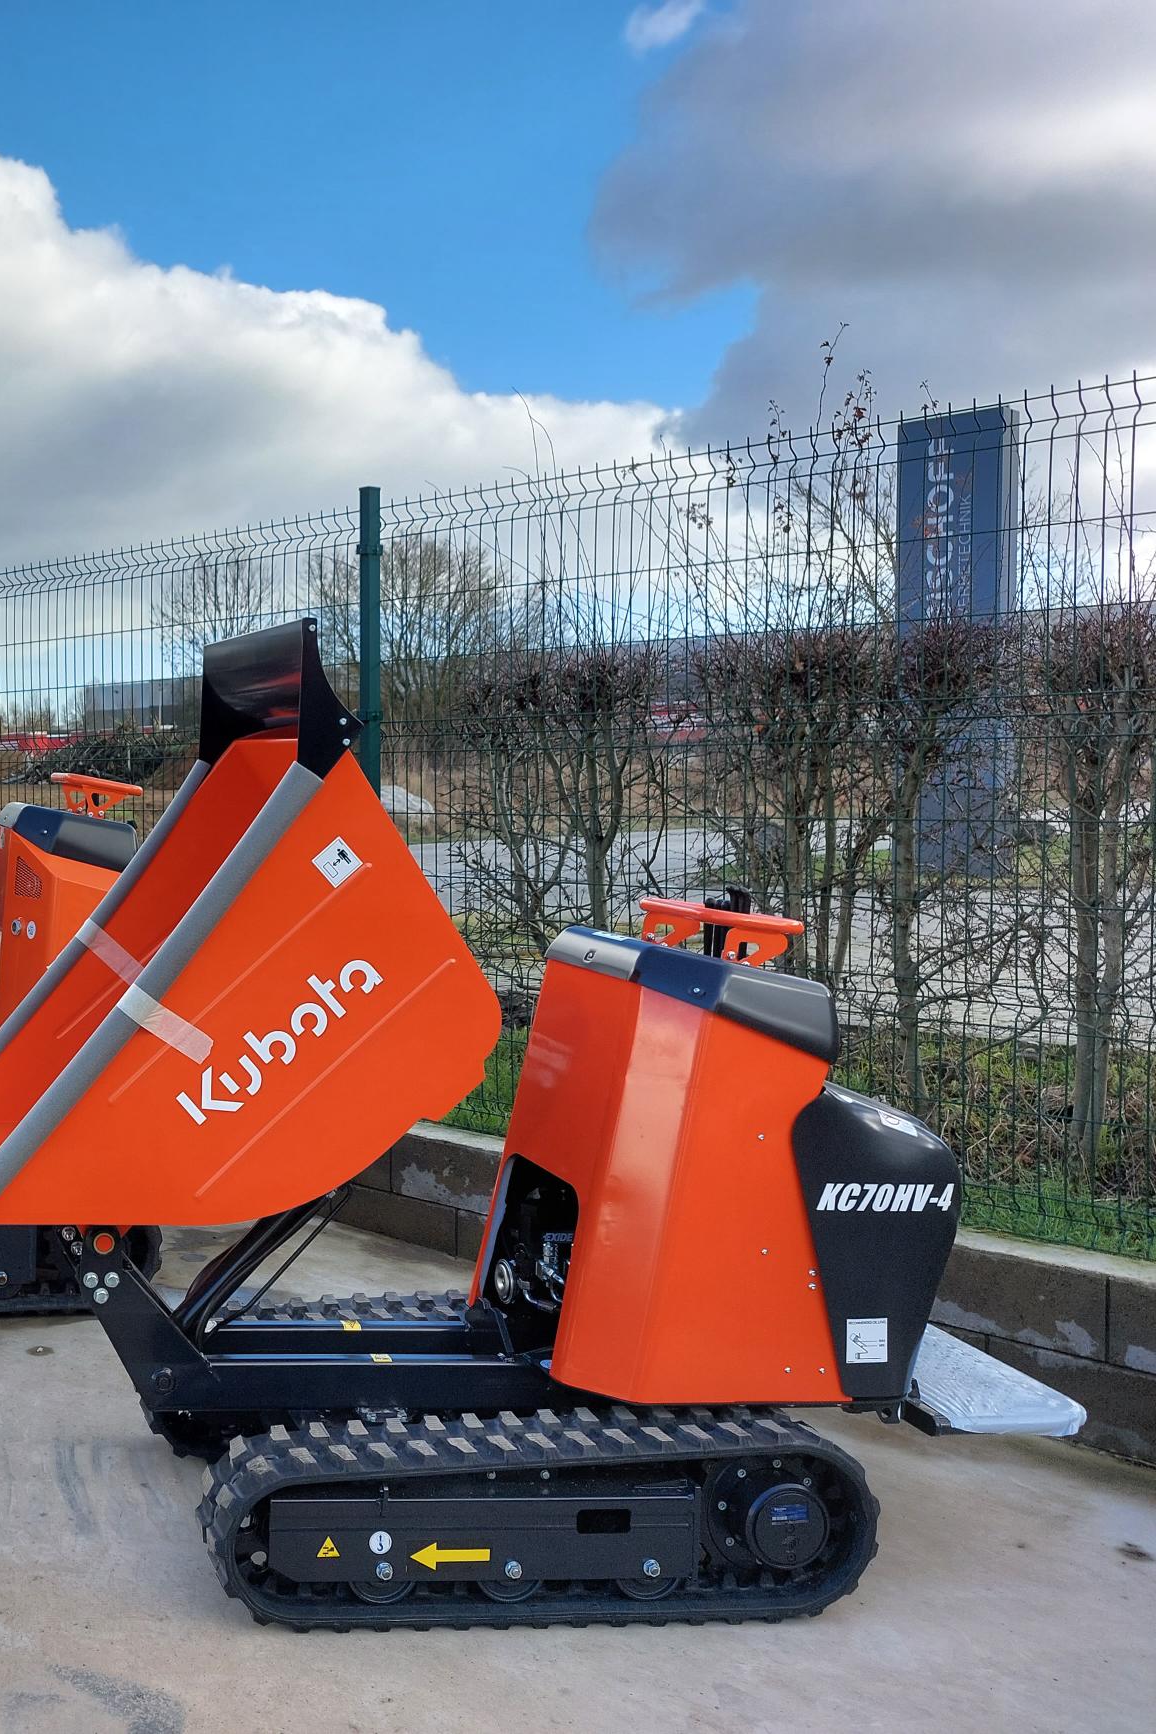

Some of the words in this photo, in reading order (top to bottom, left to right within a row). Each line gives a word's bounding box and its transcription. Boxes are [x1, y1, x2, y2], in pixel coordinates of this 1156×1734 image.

[175, 959, 384, 1126] Kubota
[815, 1183, 955, 1212] KC70HV-4
[543, 1232, 574, 1242] EXIDE
